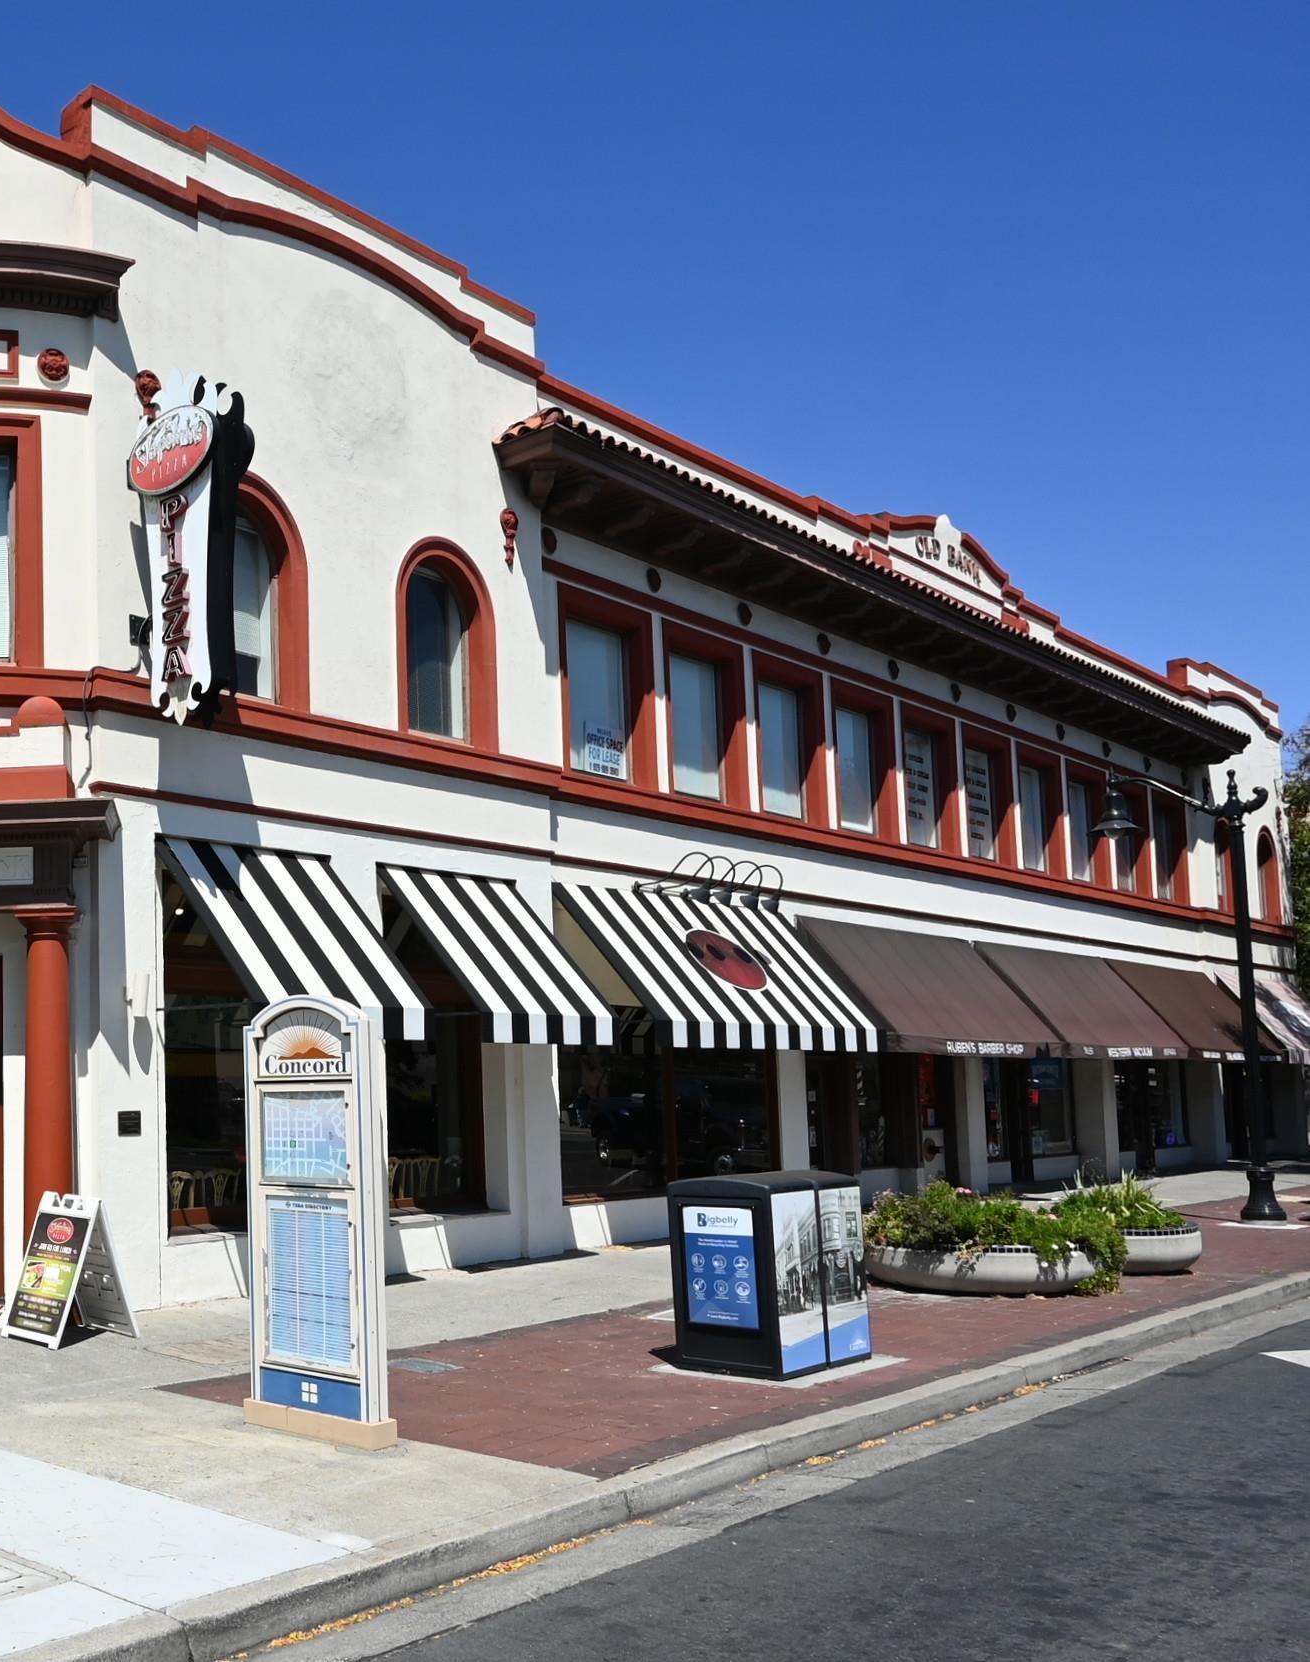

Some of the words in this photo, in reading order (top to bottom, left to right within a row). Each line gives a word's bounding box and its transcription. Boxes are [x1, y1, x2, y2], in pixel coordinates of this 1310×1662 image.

[151, 453, 187, 483] PIZZA
[915, 535, 941, 561] OLD
[947, 544, 981, 588] BANK
[160, 494, 192, 683] PIZZA
[589, 746, 601, 760] FOR
[602, 750, 620, 766] LEASE
[606, 737, 624, 754] SPACE
[946, 1041, 977, 1054] RUBEN'S
[978, 1042, 1005, 1054] BARBER
[1006, 1044, 1024, 1055] SHOP
[265, 1052, 347, 1074] Concord
[697, 1212, 739, 1227] Bigbelly
